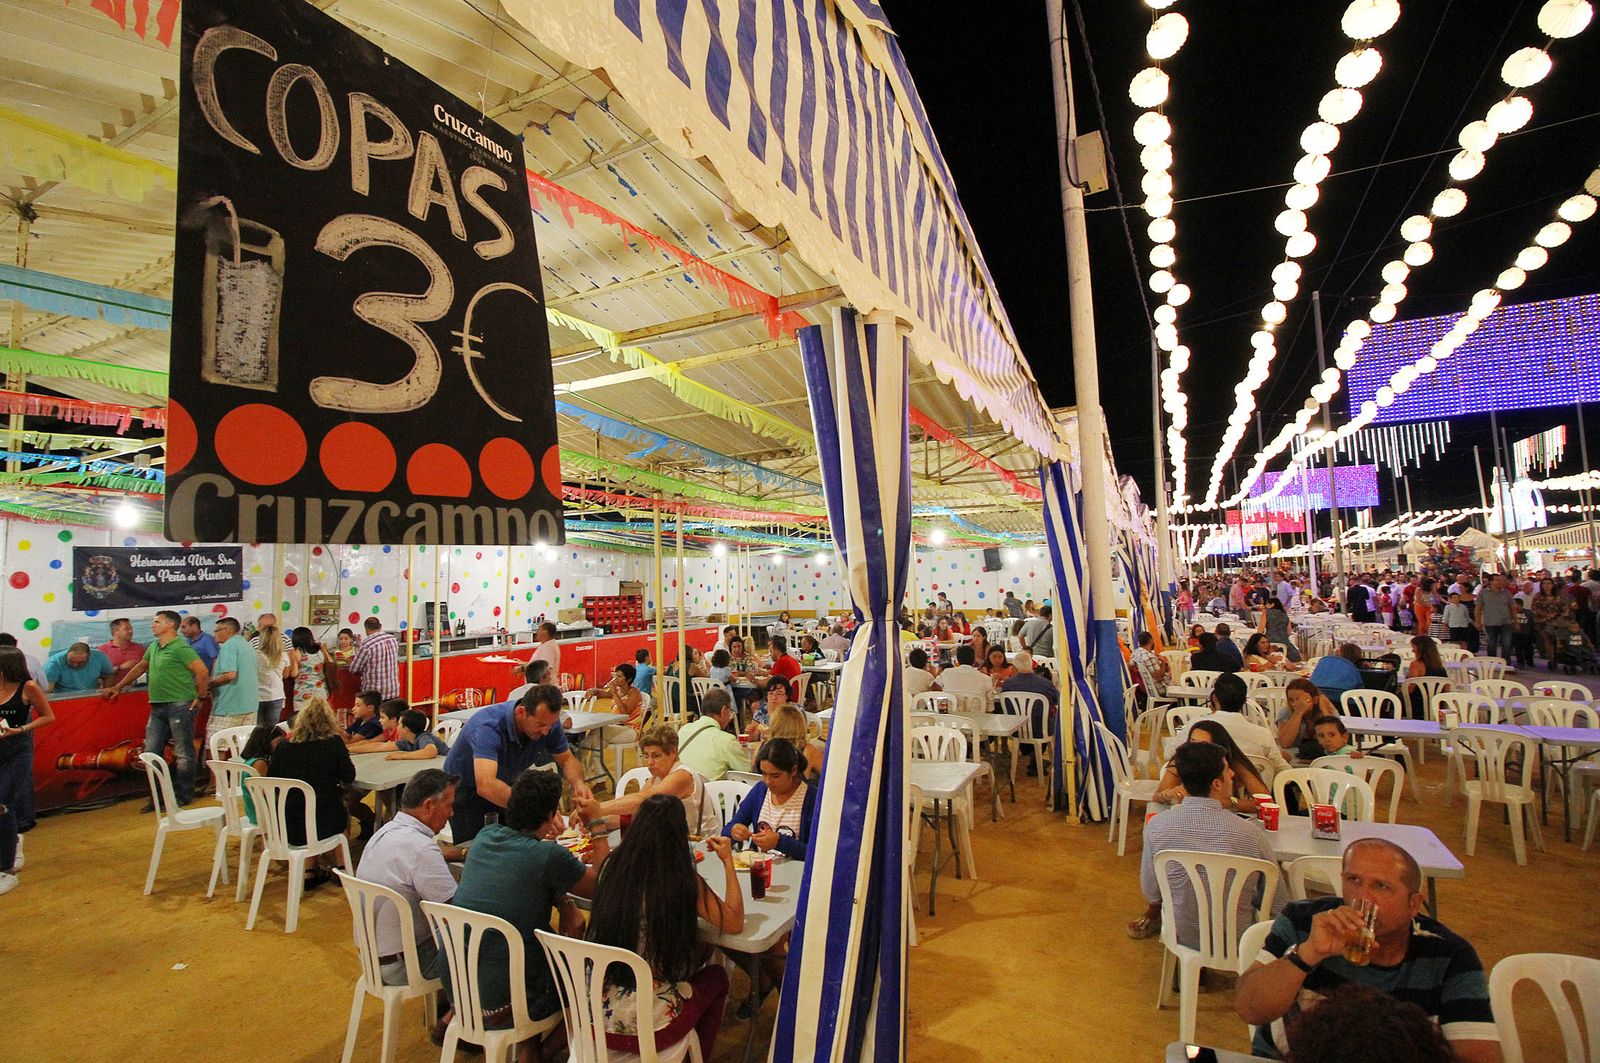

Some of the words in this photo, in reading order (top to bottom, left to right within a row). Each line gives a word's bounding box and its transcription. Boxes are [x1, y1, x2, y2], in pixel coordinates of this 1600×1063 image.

[193, 26, 515, 259] COPAS
[433, 104, 513, 163] Cruzcampo
[130, 554, 186, 568] Hermandad
[188, 553, 215, 567] Ntra.
[217, 553, 236, 566] Sra.
[135, 574, 145, 583] de
[145, 571, 157, 583] la
[158, 569, 187, 583] Peña
[187, 573, 197, 581] de
[197, 567, 233, 581] Huelva
